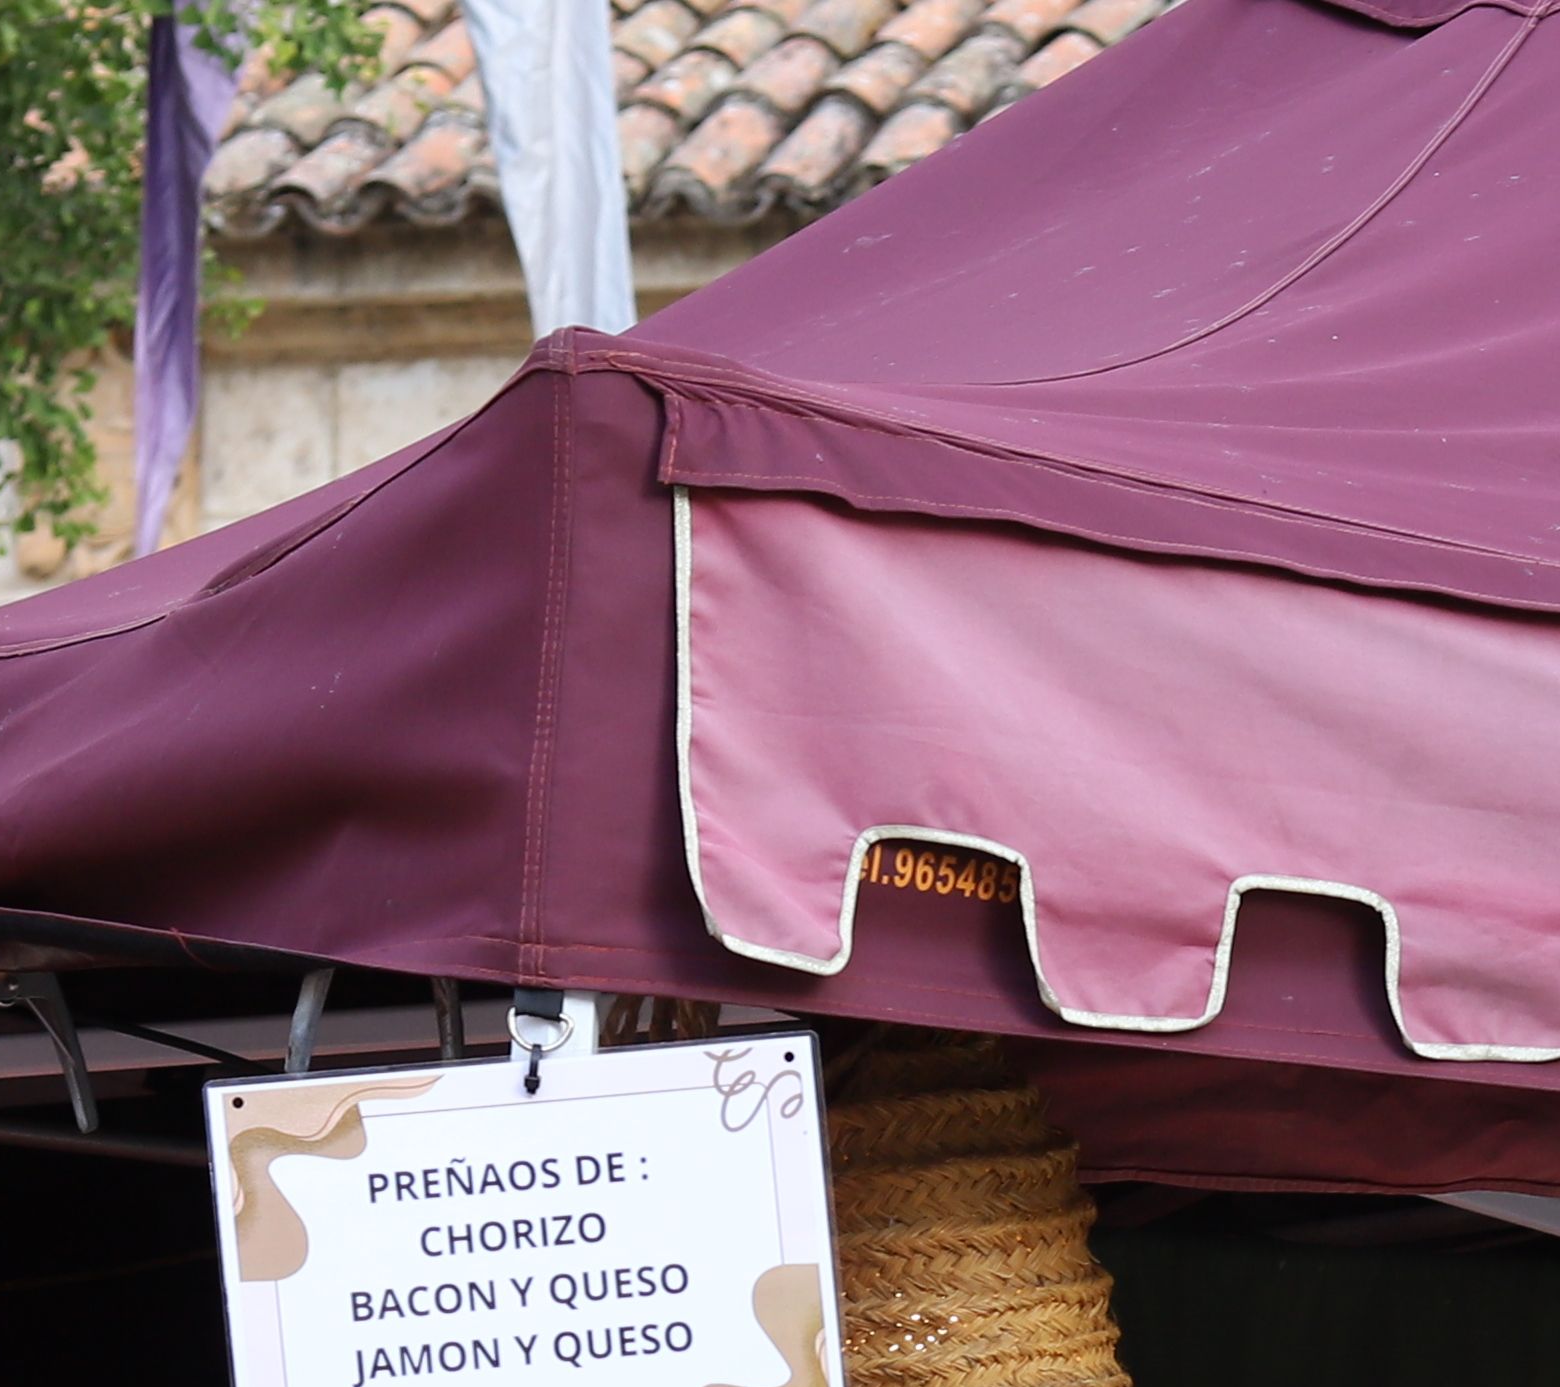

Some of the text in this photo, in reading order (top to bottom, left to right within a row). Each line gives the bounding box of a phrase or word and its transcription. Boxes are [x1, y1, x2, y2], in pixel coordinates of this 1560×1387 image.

[368, 1158, 561, 1204] PREÑAOS
[575, 1152, 626, 1186] DE
[420, 1212, 606, 1257] CHORIZO
[350, 1263, 689, 1322] BACON Y QUESO
[514, 1334, 538, 1365] Y
[553, 1321, 693, 1367] QUESO
